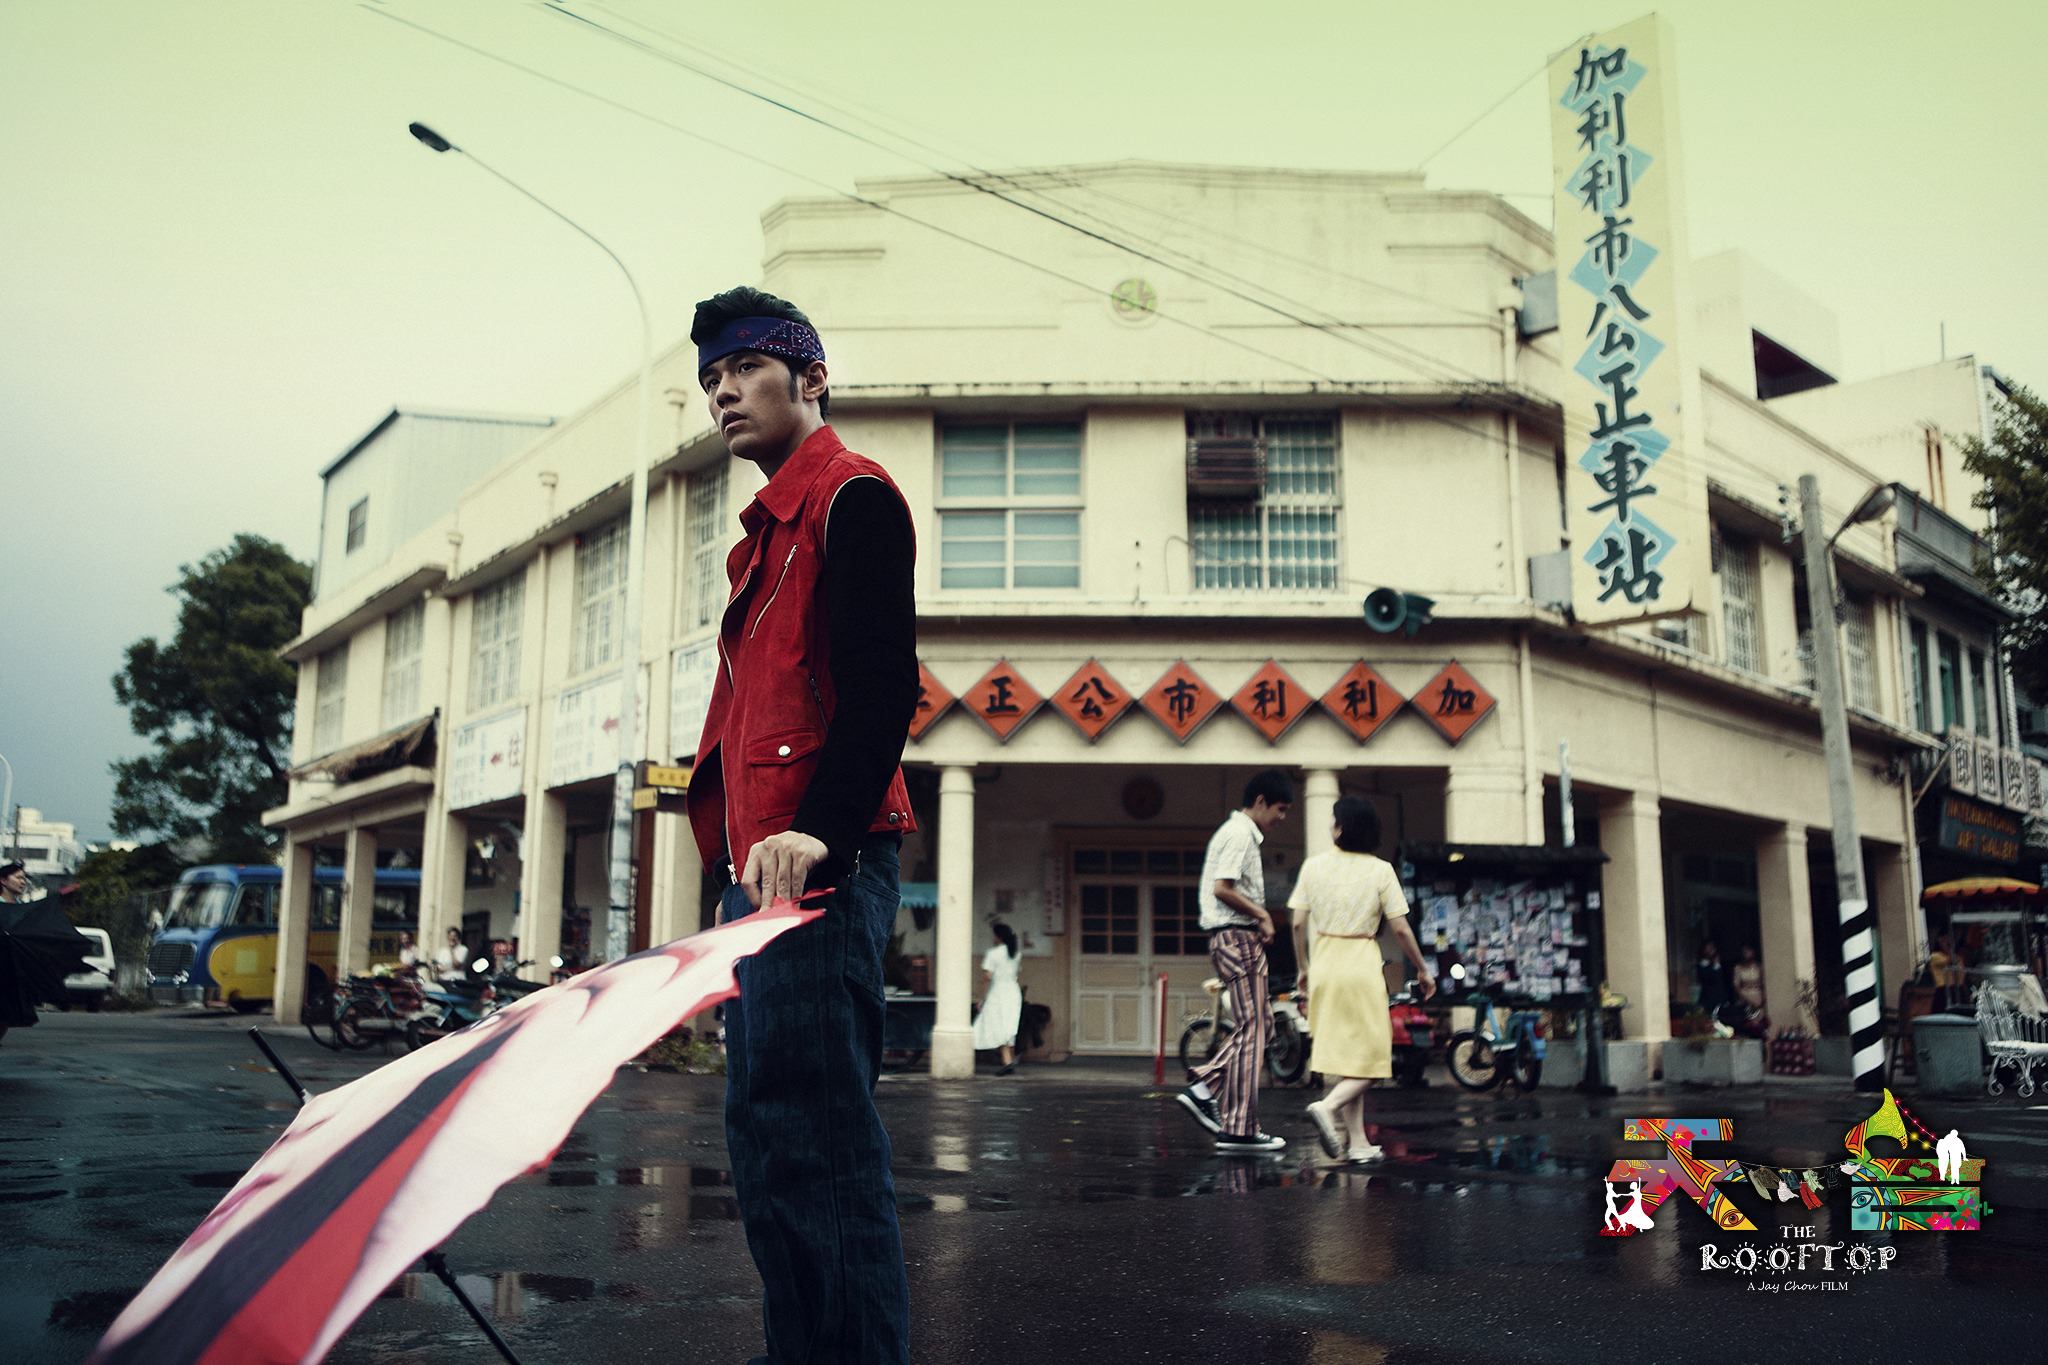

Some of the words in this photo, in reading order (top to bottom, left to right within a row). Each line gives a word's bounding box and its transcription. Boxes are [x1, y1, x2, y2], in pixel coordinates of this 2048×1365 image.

[1572, 45, 1665, 604] 加利利市公正車站
